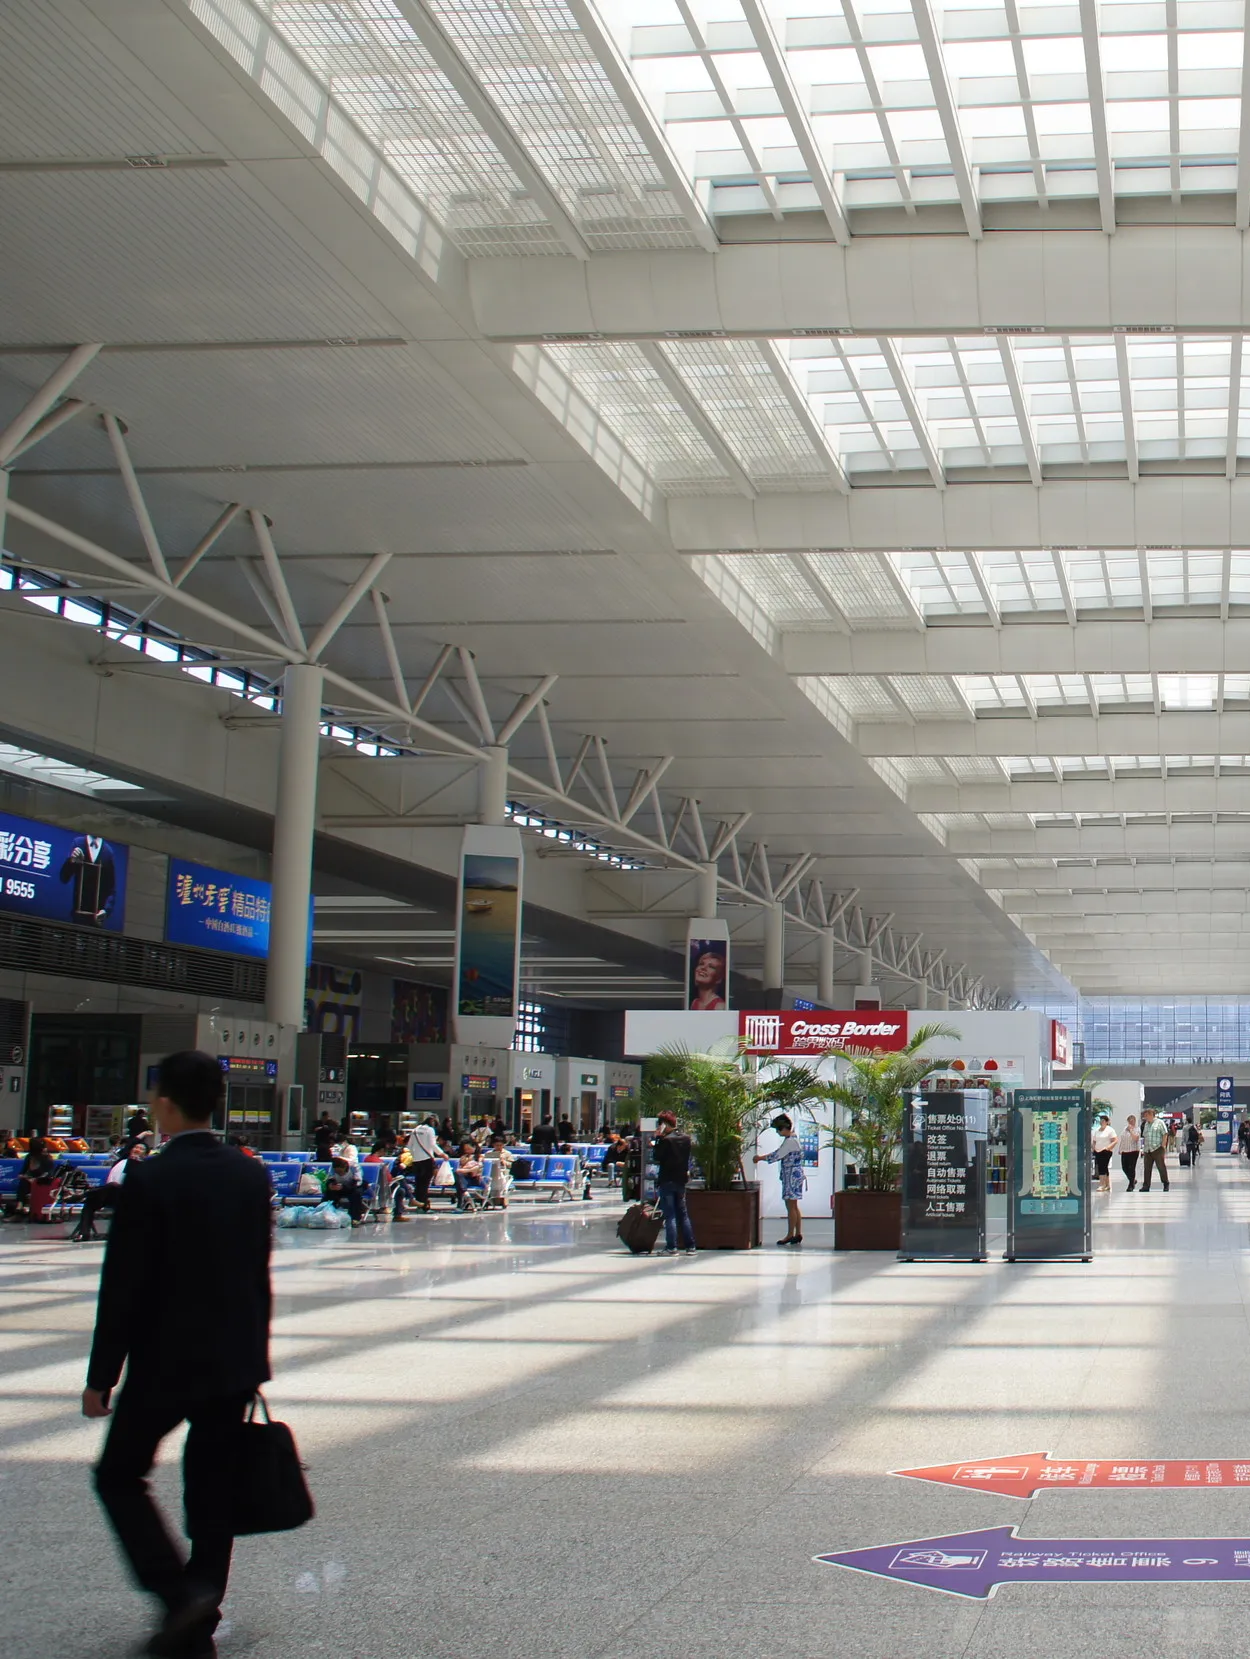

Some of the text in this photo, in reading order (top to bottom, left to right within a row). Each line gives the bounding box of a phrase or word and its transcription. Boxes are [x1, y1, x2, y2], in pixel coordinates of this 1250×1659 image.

[6, 879, 36, 899] 9555
[790, 1020, 900, 1036] Cross Border
[927, 1113, 977, 1126] 售票处9(11)
[927, 1134, 947, 1145] 改签
[926, 1151, 947, 1161] 退票
[927, 1168, 966, 1178] 自动售票
[926, 1184, 966, 1194] 网络取票
[925, 1202, 965, 1212] 人工售票
[1036, 1466, 1079, 1481] 候车
[1107, 1466, 1148, 1481] 检票
[998, 1557, 1218, 1568] 铁路售票 9
